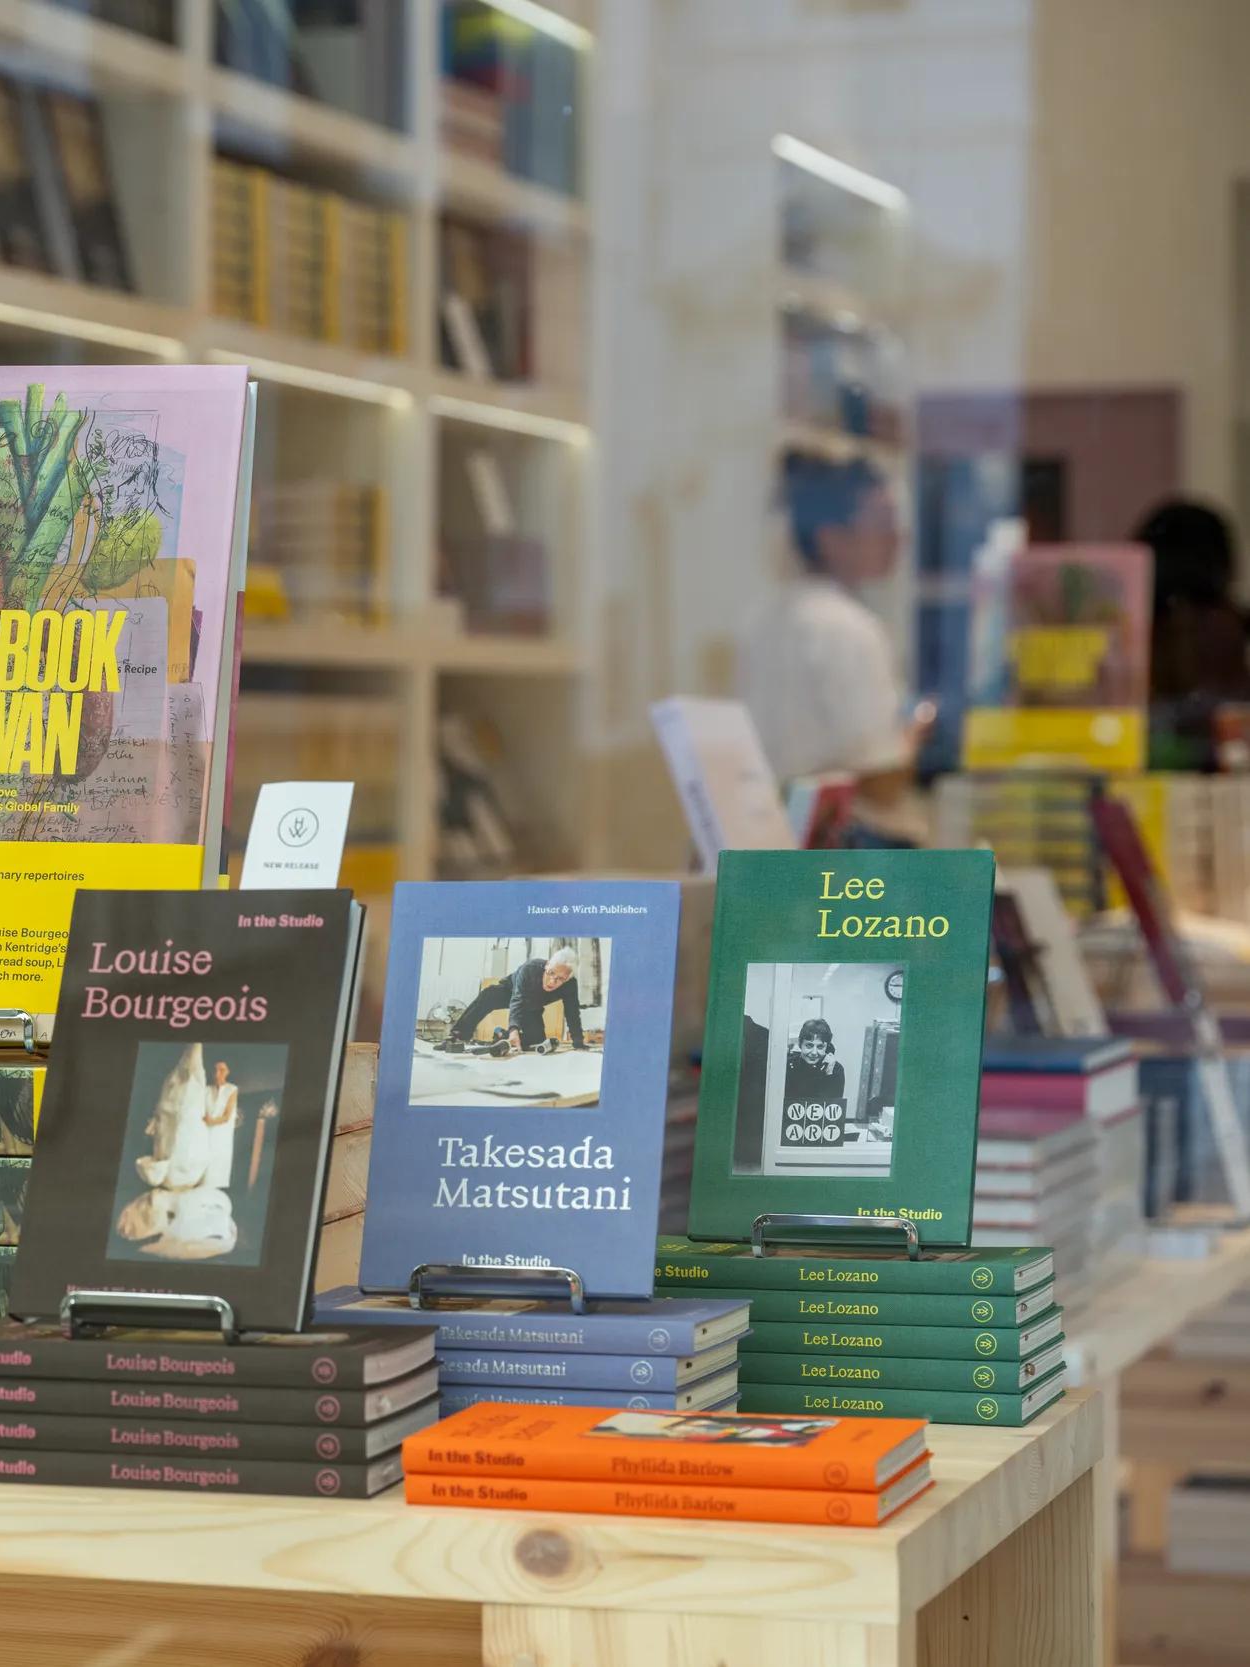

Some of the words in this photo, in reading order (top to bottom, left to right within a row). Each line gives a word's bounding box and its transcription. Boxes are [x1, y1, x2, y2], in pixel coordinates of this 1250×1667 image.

[124, 663, 158, 676] Recipe
[5, 801, 41, 813] Global
[43, 801, 80, 815] Family
[263, 862, 283, 870] NEW
[284, 862, 320, 870] RELEASE
[23, 870, 85, 882] repertoires
[819, 871, 886, 900] Lee
[527, 904, 560, 915] Hauser
[561, 905, 570, 915] &
[571, 904, 598, 915] Wirth
[599, 904, 648, 915] Publishers
[238, 914, 252, 928] In
[253, 914, 277, 928] the
[279, 914, 324, 928] Studio
[817, 909, 949, 938] Lozano
[21, 927, 69, 941] Bourgeo
[5, 942, 67, 954] Kentridge's
[25, 958, 55, 969] soup,
[88, 940, 213, 975] Louise
[12, 973, 44, 982] more.
[81, 985, 268, 1028] Bourgeois
[788, 1103, 843, 1120] NEW
[787, 1124, 841, 1141] ART
[438, 1135, 614, 1169] Takesada
[432, 1176, 632, 1211] Matsutani
[898, 1208, 943, 1221] Studio
[462, 1253, 476, 1267] In
[478, 1254, 502, 1267] the
[504, 1254, 551, 1267] Studio
[664, 1264, 709, 1279] Studio
[799, 1268, 825, 1283] Lee
[827, 1269, 879, 1284] Lozano
[799, 1301, 825, 1315] Lee
[827, 1301, 879, 1316] Lozano
[439, 1325, 507, 1343] Takesada
[508, 1327, 585, 1346] Matsutani
[106, 1353, 157, 1373] Louise
[158, 1356, 235, 1377] Bourgeois
[492, 1359, 567, 1377] Matsutani
[801, 1364, 827, 1378] Lee
[829, 1364, 880, 1379] Lozano
[110, 1390, 161, 1409] Louise
[162, 1393, 239, 1413] Bourgeois
[804, 1395, 830, 1409] Lee
[832, 1396, 884, 1411] Lozano
[428, 1449, 445, 1463] In
[447, 1450, 472, 1465] the
[474, 1451, 525, 1467] Studio
[110, 1463, 161, 1482] Louise
[162, 1466, 239, 1486] Bourgeois
[611, 1456, 675, 1476] Phyllida
[678, 1460, 734, 1477] Barlow
